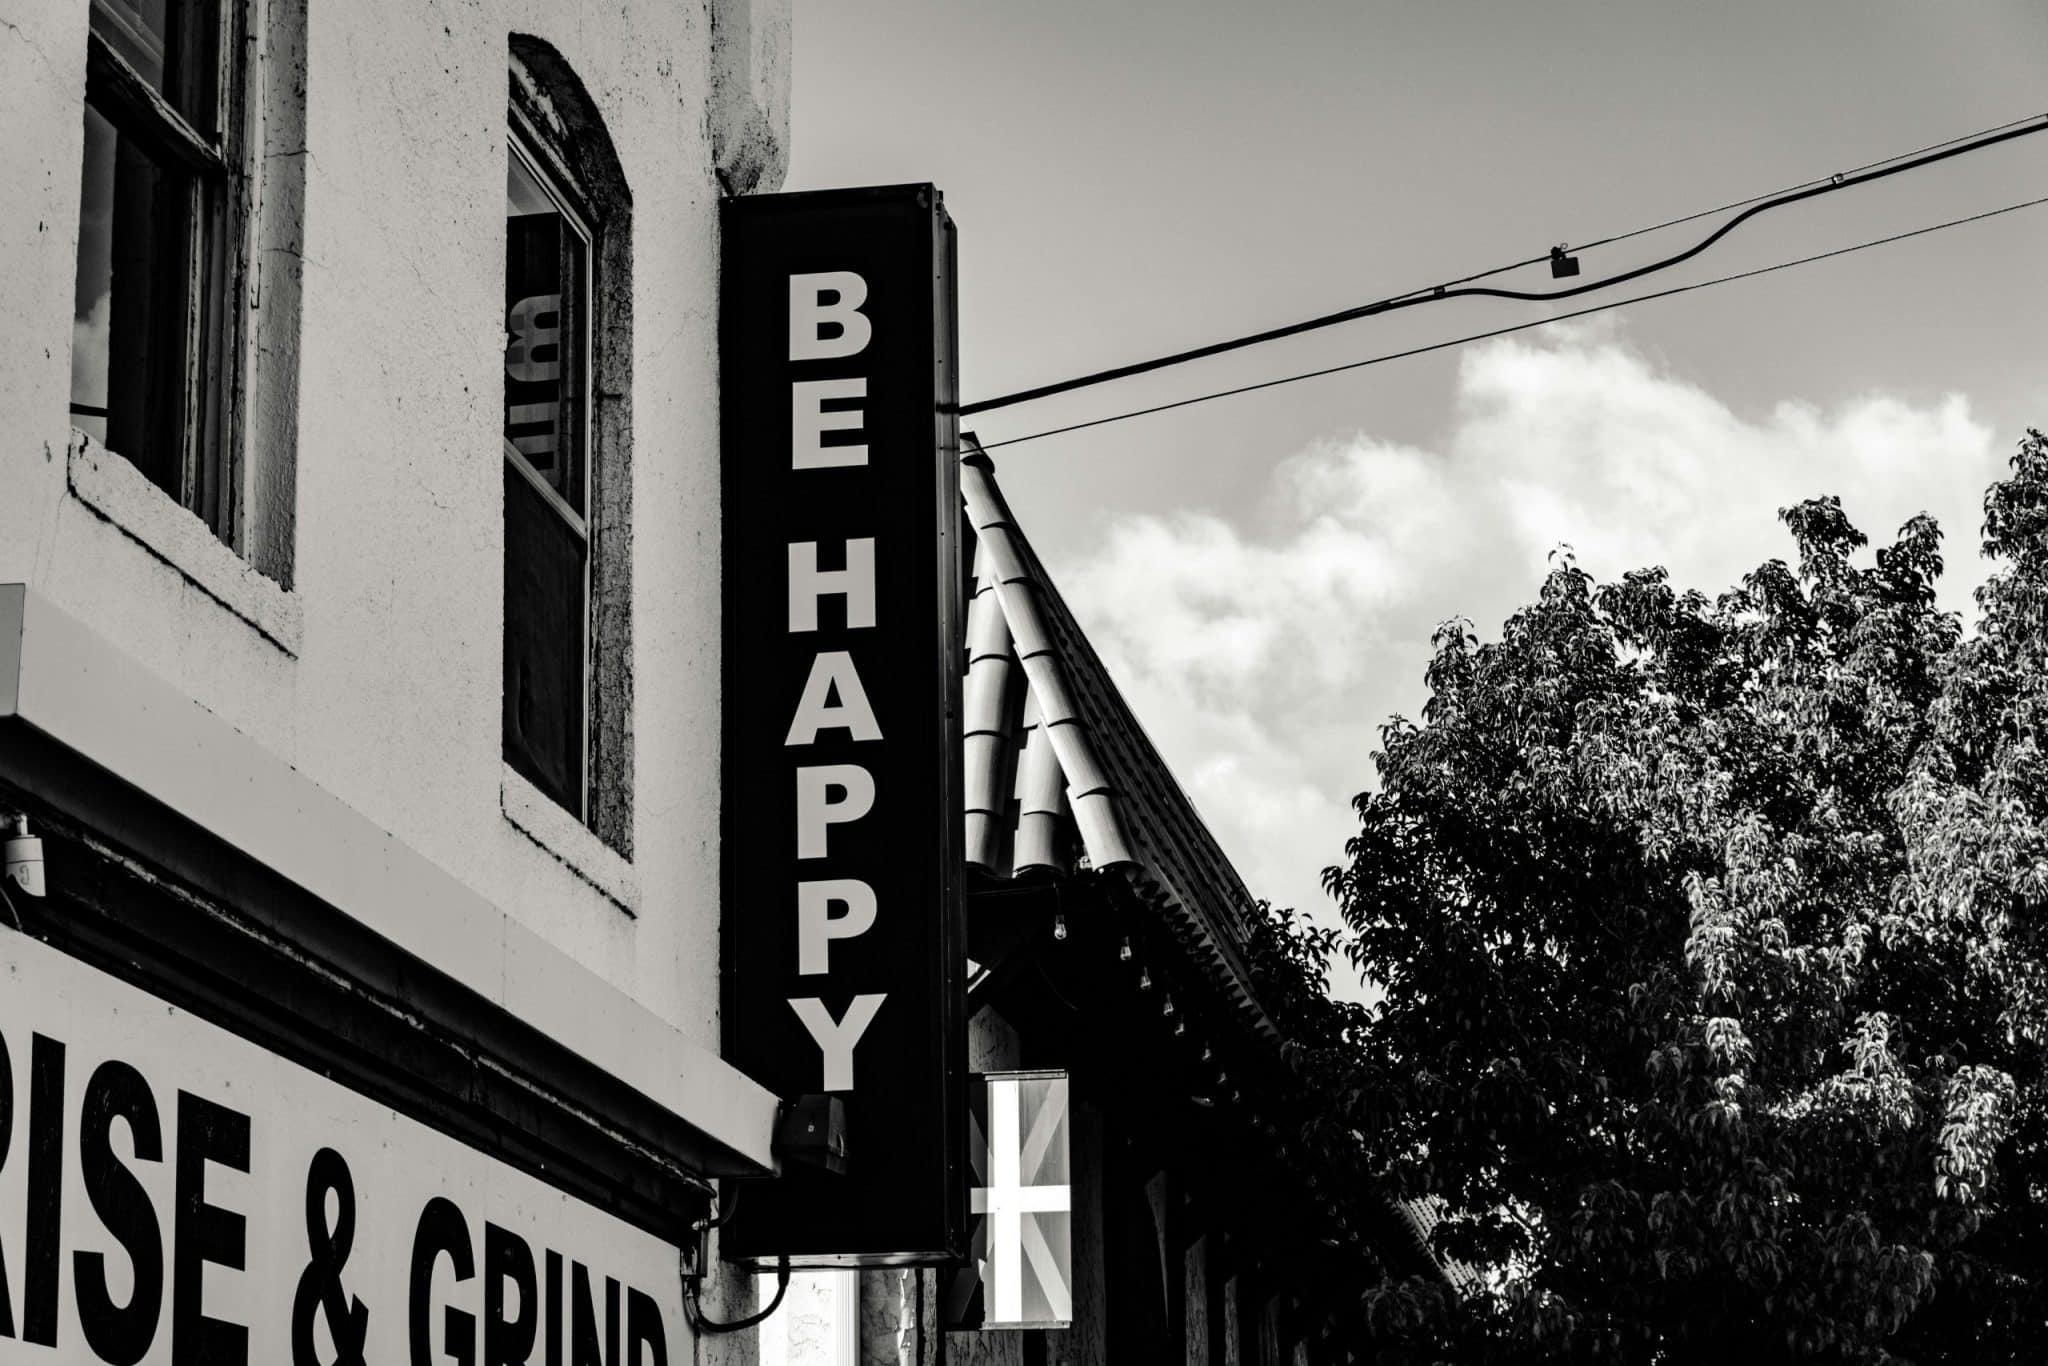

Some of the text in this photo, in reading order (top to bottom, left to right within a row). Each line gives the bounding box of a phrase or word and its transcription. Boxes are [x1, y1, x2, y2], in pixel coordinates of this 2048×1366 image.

[786, 271, 888, 1091] BE HAPPY
[0, 1028, 251, 1366] ISE
[292, 1147, 369, 1366] &
